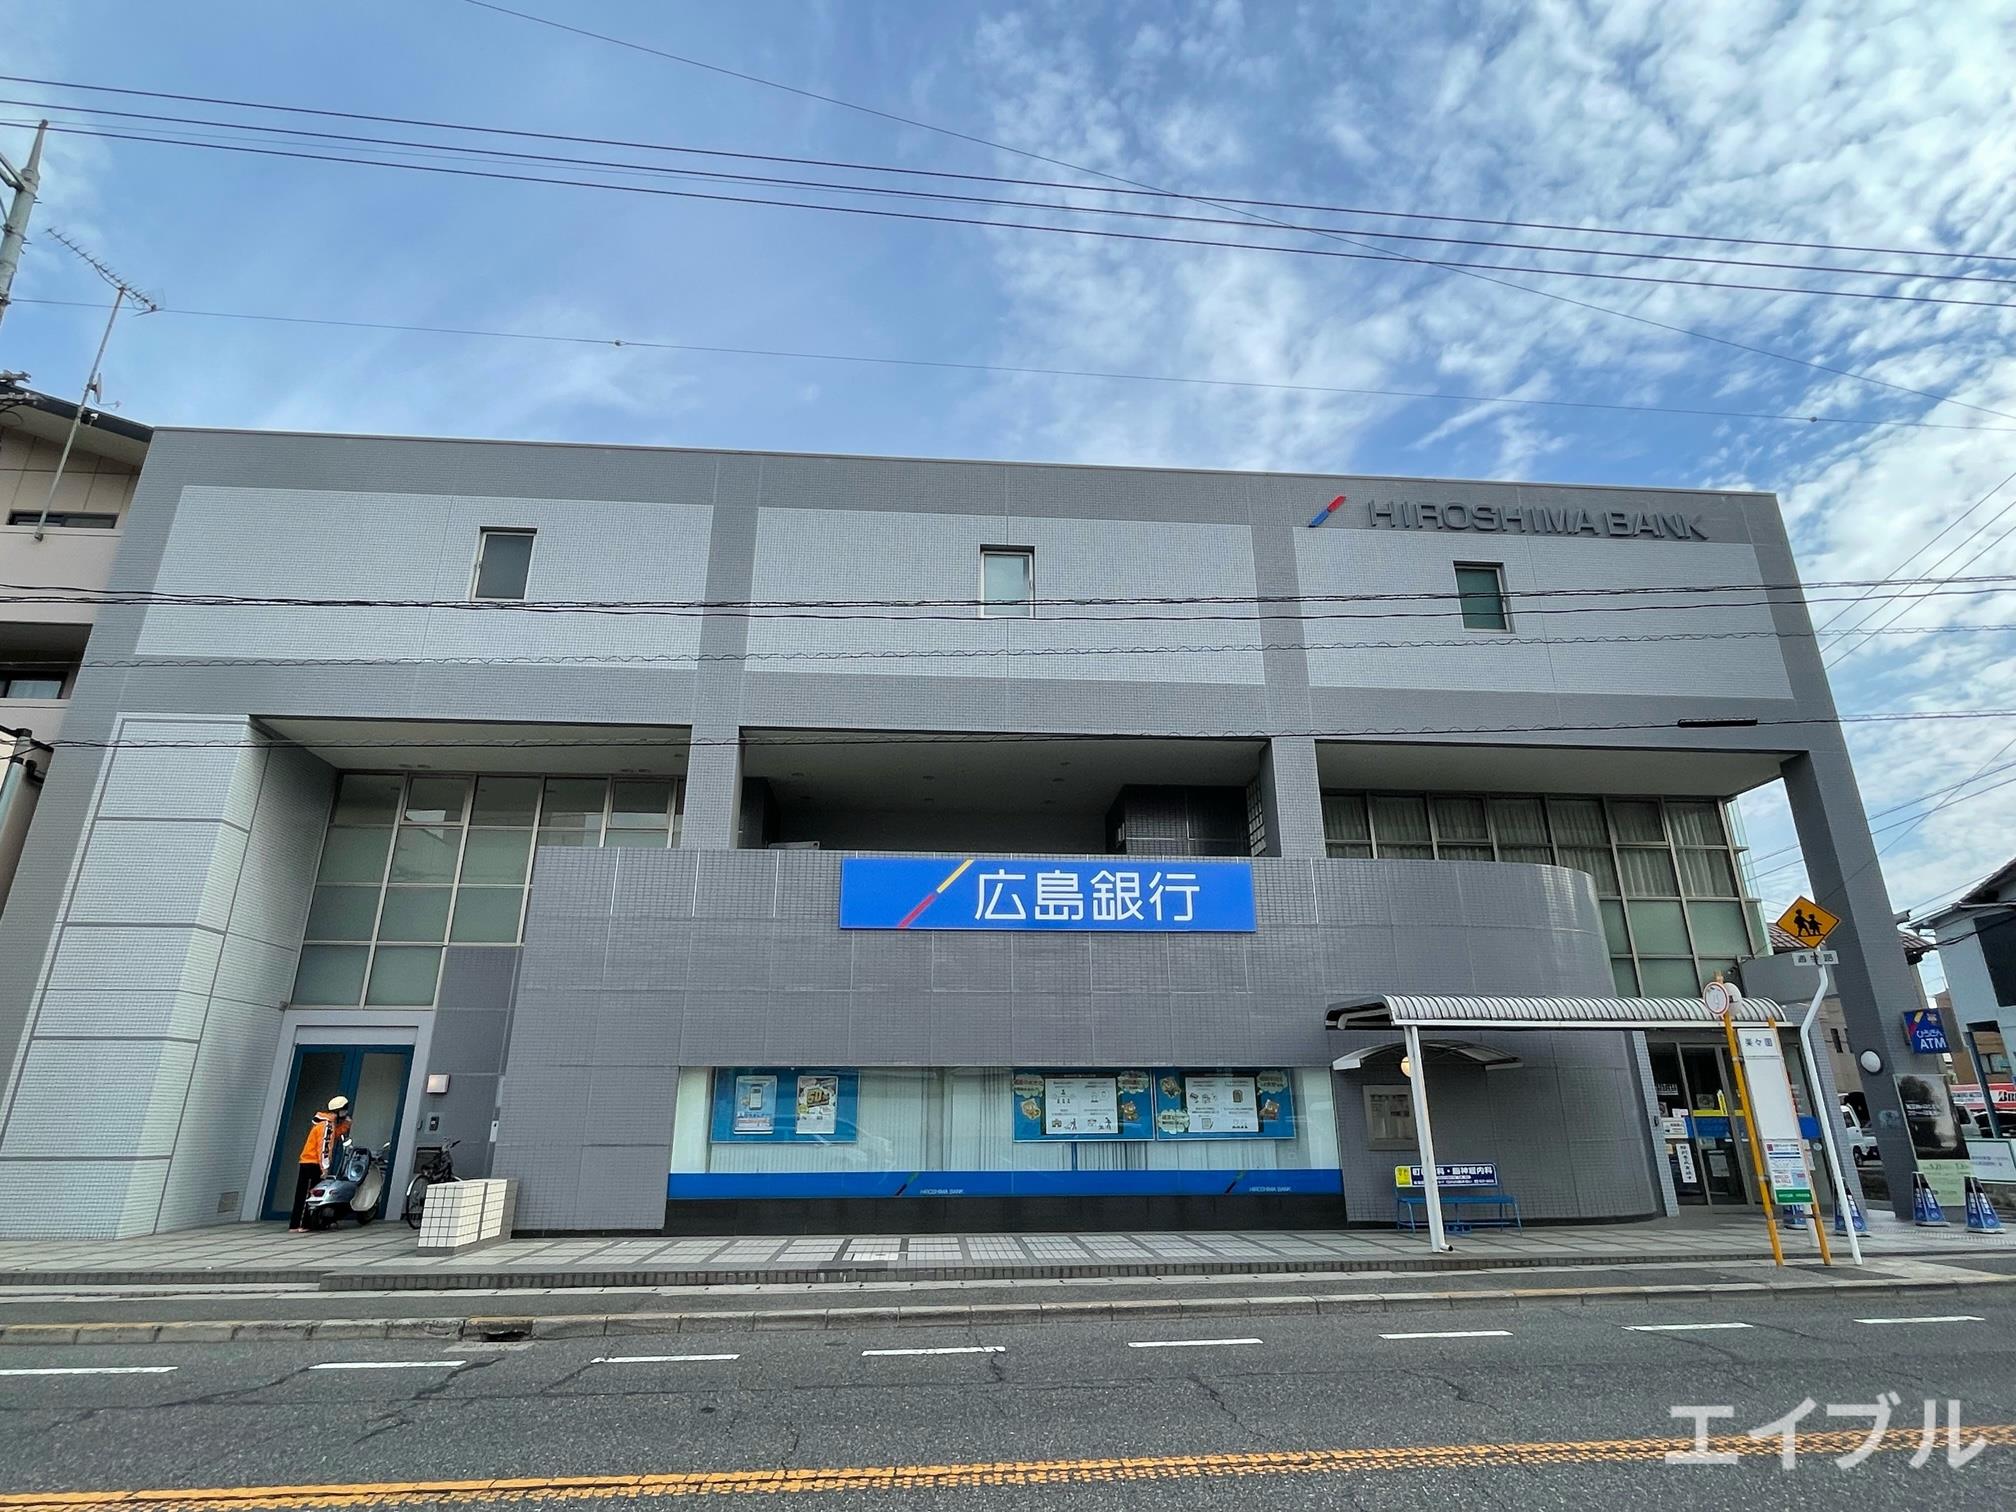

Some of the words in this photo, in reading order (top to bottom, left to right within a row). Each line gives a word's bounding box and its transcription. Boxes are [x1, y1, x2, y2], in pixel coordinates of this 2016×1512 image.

[1367, 499, 1600, 535] HIROSHIMA
[1603, 509, 1708, 540] BANK
[974, 869, 1200, 922] 広島銀行
[1920, 1037, 1947, 1050] ATM
